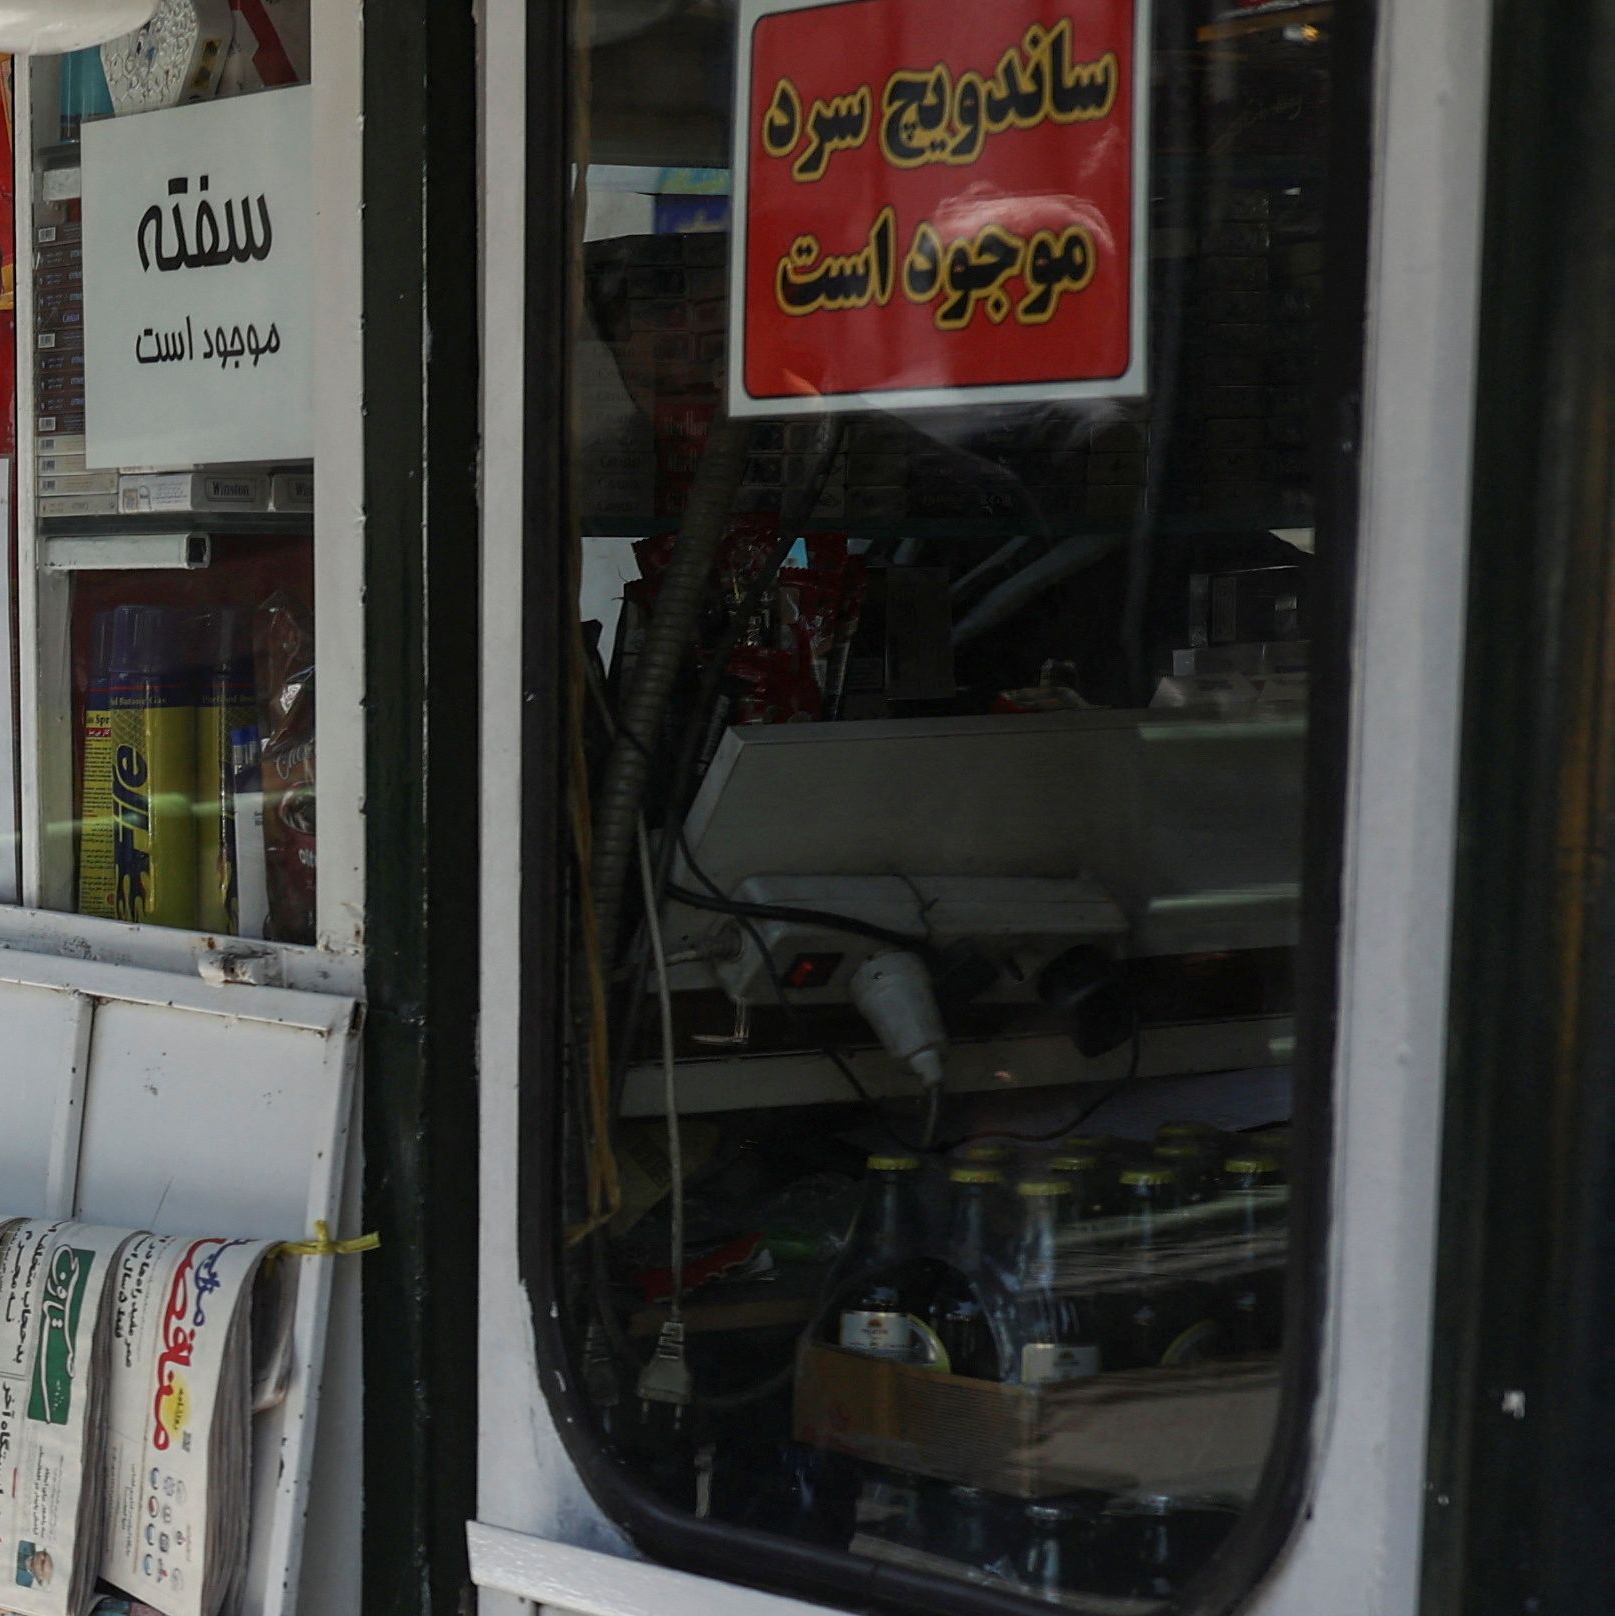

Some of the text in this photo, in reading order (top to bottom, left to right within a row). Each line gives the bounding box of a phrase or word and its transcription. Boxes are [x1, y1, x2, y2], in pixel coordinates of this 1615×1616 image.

[764, 17, 1118, 181] ساندویچ سرد
[138, 175, 272, 272] سفته
[776, 205, 1095, 331] موجود است
[136, 316, 280, 369] موجود است
[213, 481, 249, 496] Winston
[113, 1306, 125, 1338] فقط
[119, 1257, 133, 1288] سال
[126, 1301, 141, 1337] مفید
[121, 1338, 135, 1368] عمر
[0, 1381, 17, 1418] آخر
